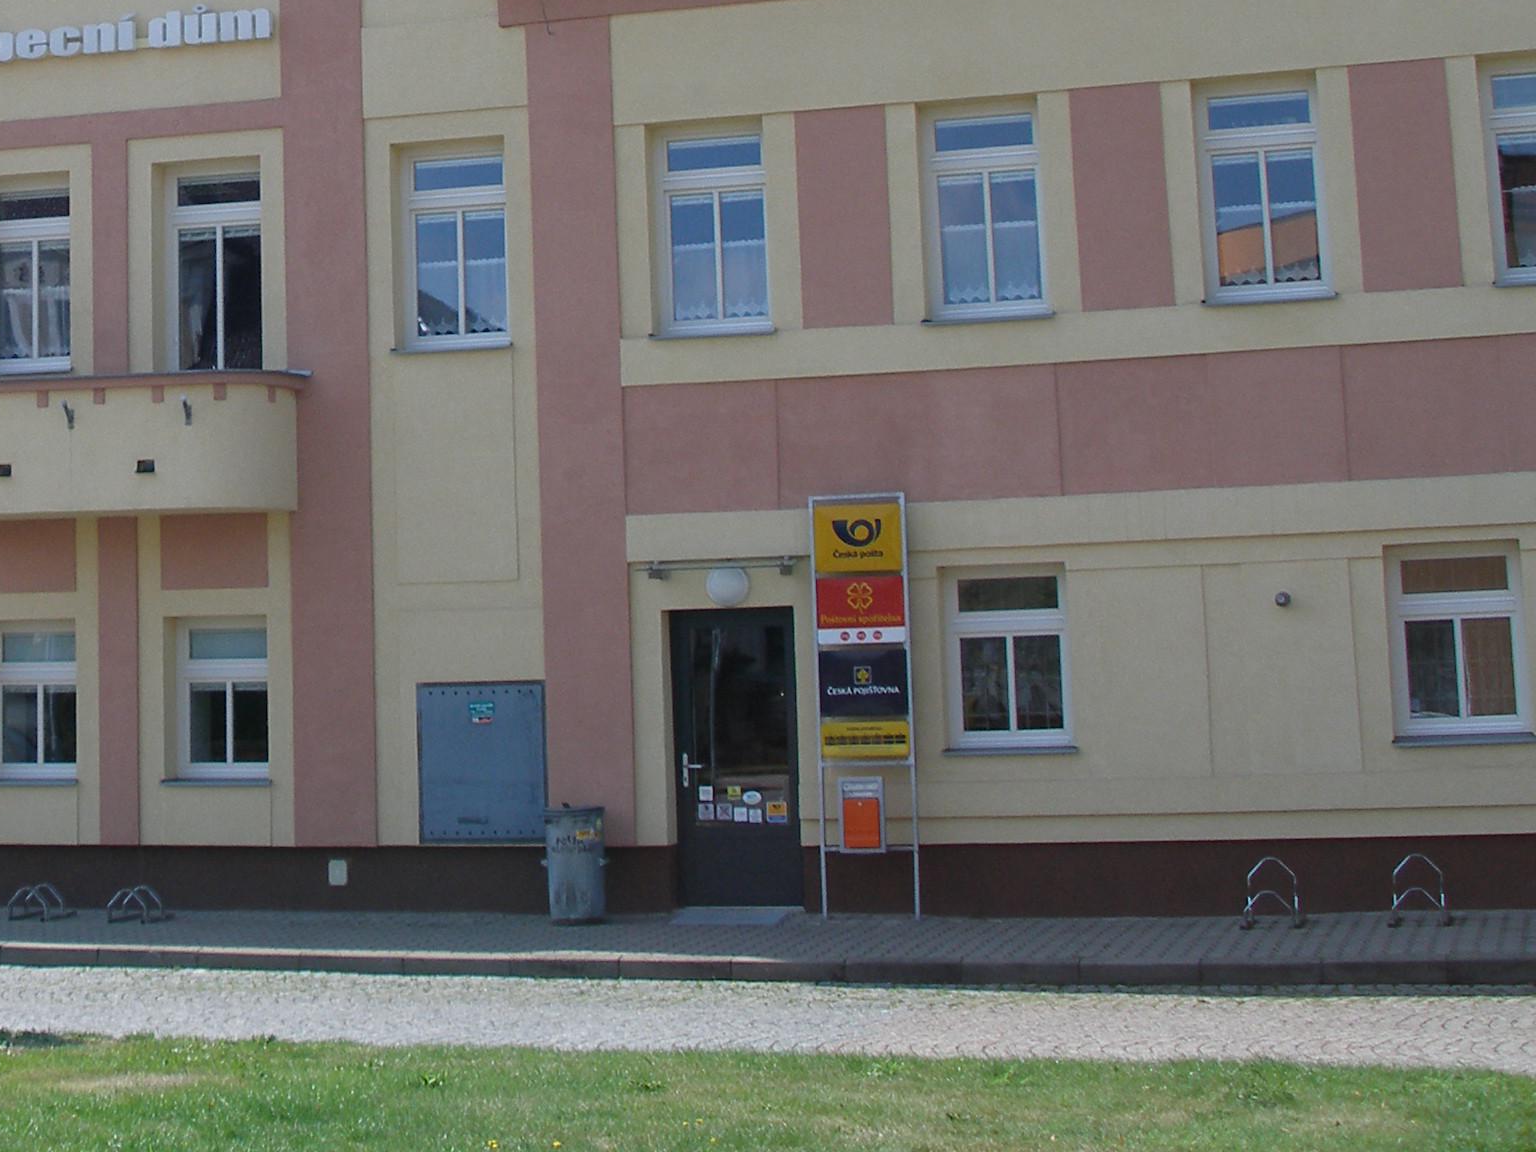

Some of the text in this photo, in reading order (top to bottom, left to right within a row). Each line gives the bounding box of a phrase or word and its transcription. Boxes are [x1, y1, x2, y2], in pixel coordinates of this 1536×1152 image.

[148, 3, 272, 48] dům
[832, 549, 884, 559] Česká pošta
[827, 686, 852, 696] ČESKÁ
